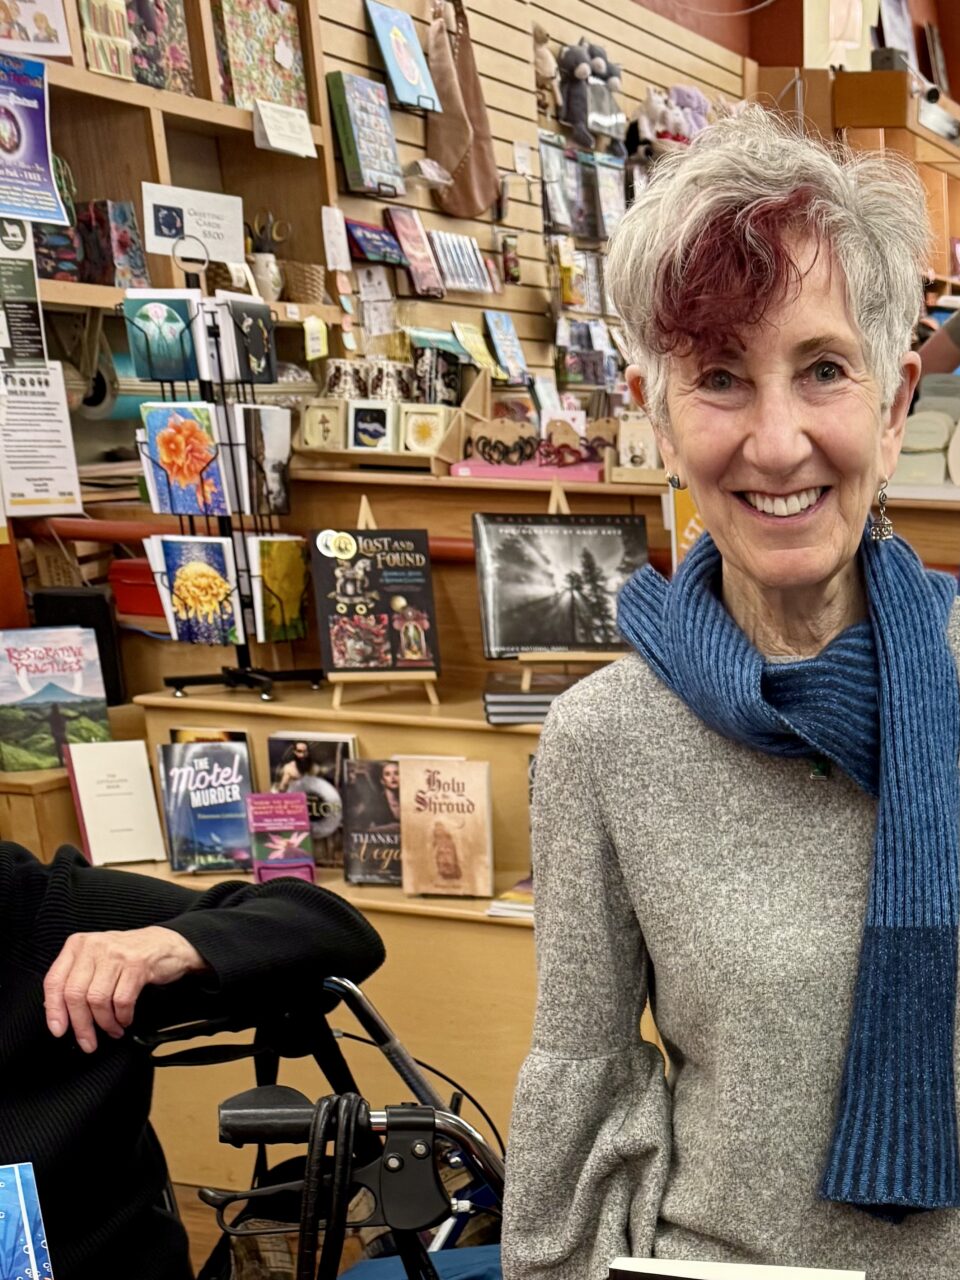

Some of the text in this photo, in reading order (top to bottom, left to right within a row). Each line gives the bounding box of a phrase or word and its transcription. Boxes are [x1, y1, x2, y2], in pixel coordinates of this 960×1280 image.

[356, 535, 414, 557] LOST AND
[376, 552, 426, 569] FOUND
[6, 646, 84, 663] RESTORATIVE
[12, 660, 84, 676] PRACTICES
[168, 753, 244, 793] Motel
[193, 756, 210, 771] THE
[424, 768, 467, 797] Holy
[190, 784, 242, 808] MURDER
[413, 789, 476, 816] Shroud
